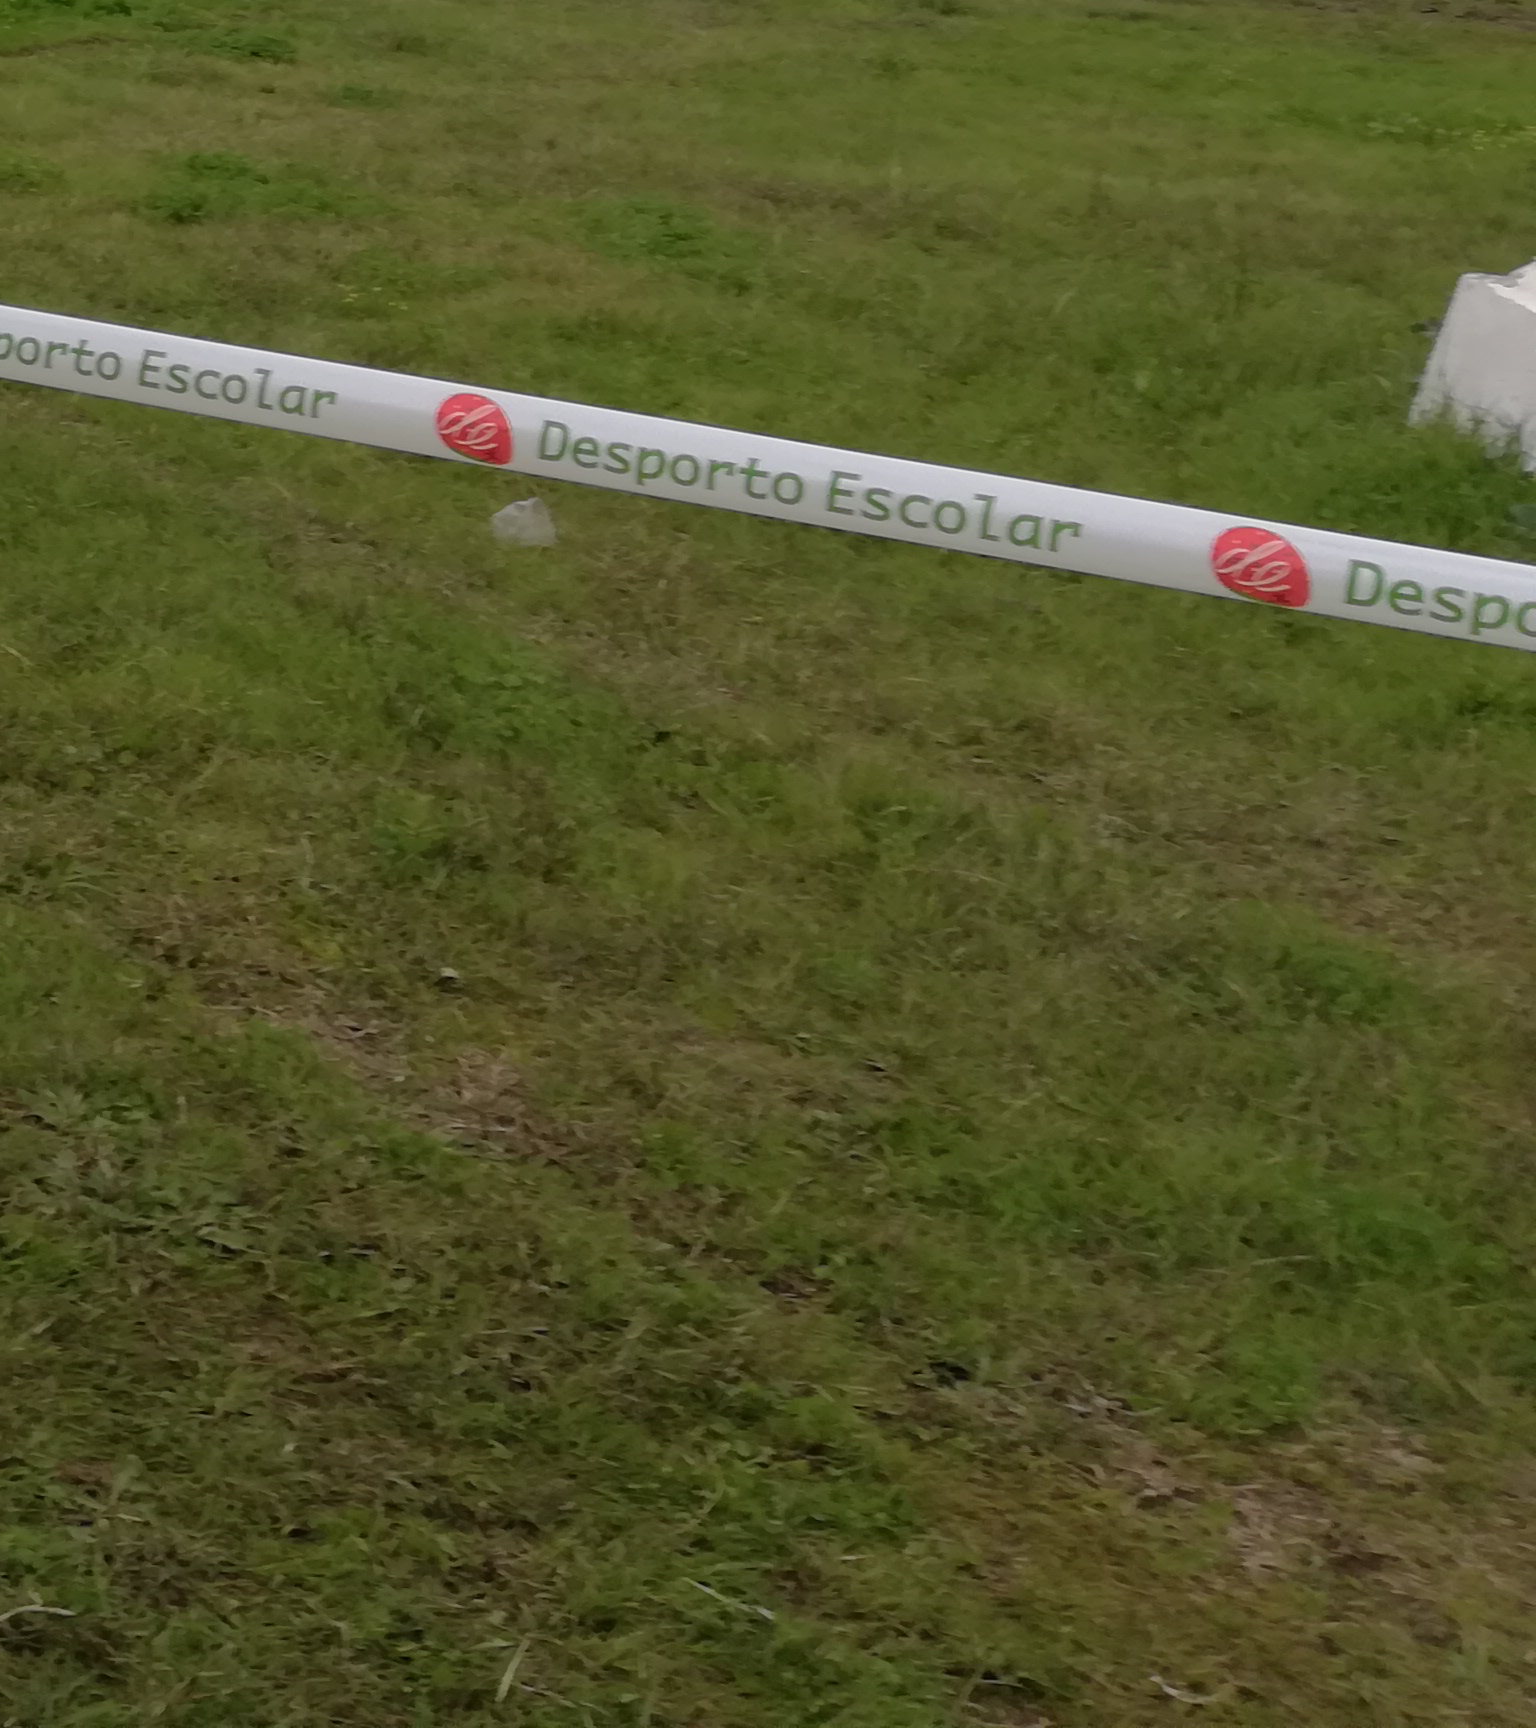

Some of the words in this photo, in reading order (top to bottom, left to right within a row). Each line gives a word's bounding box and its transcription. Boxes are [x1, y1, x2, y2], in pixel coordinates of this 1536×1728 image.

[137, 349, 339, 419] Escolar
[538, 419, 805, 506] Desporto
[824, 470, 1083, 553] Escolar
